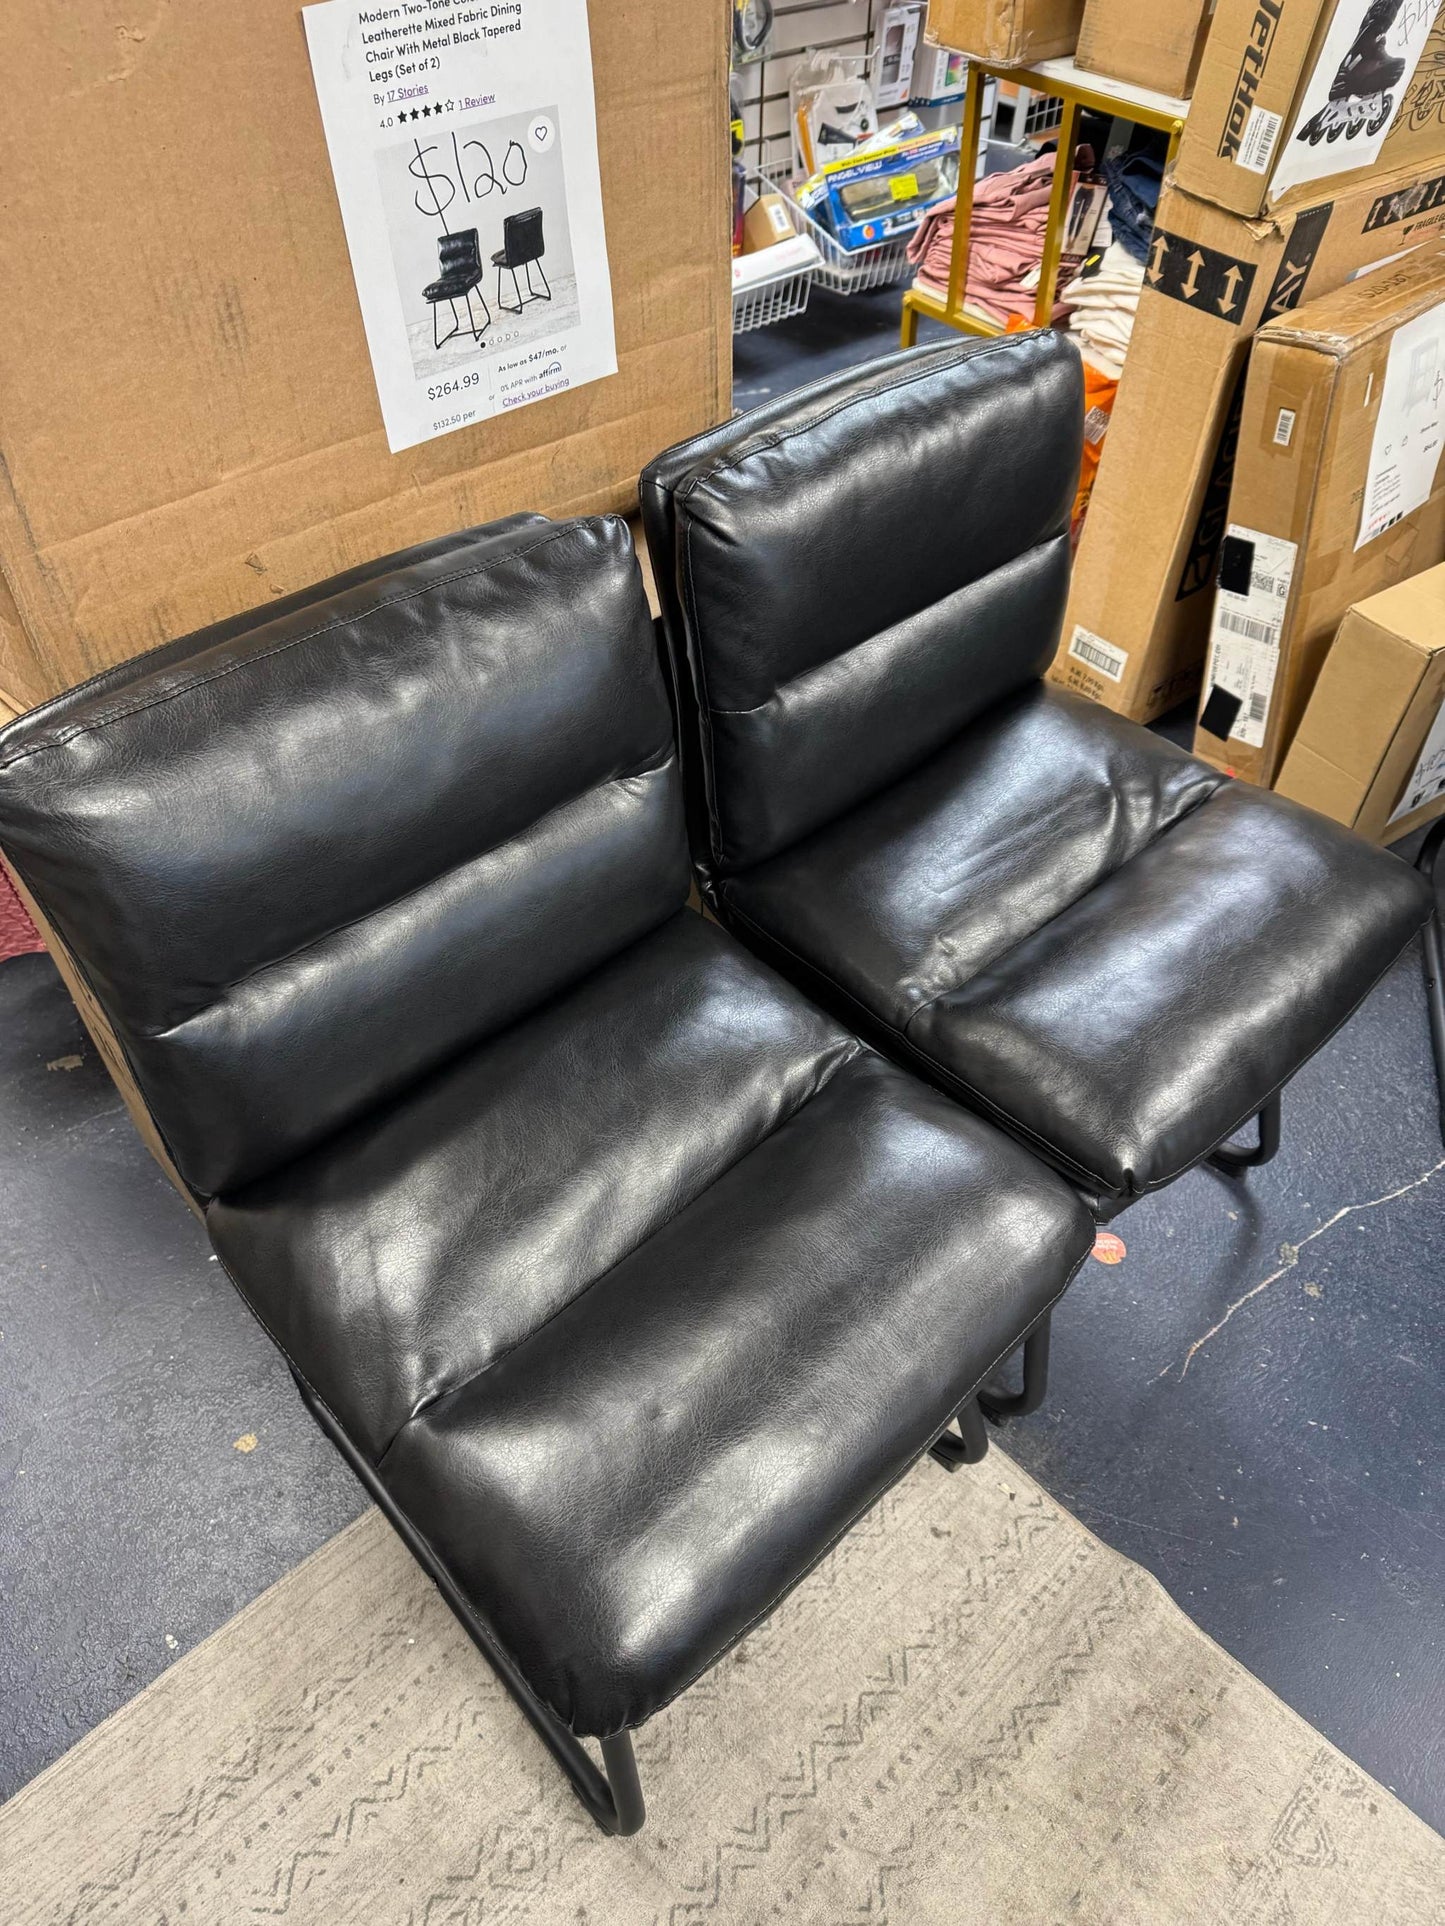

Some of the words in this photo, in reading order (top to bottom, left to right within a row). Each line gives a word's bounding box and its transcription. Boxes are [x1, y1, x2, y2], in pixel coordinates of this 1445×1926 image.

[359, 9, 400, 24] Modern
[402, 0, 450, 16] Two-Tone
[362, 23, 422, 44] Leatherette
[425, 13, 455, 31] Mixed
[458, 8, 488, 24] Fabric
[491, 3, 522, 17] Dining
[365, 47, 394, 63] Chair
[395, 42, 420, 57] With
[422, 35, 451, 51] Metal
[453, 29, 480, 44] Black
[482, 19, 521, 39] Tapered
[369, 69, 393, 83] Legs
[395, 62, 416, 78] (Set
[418, 59, 428, 71] of
[430, 56, 440, 69] 2)
[373, 93, 385, 106] By
[387, 90, 395, 102] 17
[397, 83, 429, 98] Stories
[465, 93, 496, 108] Review
[379, 117, 394, 129] 4.0
[408, 131, 527, 236] $120
[528, 348, 559, 363] $47/mo.
[427, 372, 480, 401] $264.99
[510, 379, 523, 389] APR
[524, 375, 538, 384] with
[539, 364, 562, 379] affirm
[502, 392, 527, 407] Check
[527, 387, 543, 399] your
[545, 378, 570, 392] buying
[433, 414, 461, 431] $132.50
[462, 410, 476, 422] per
